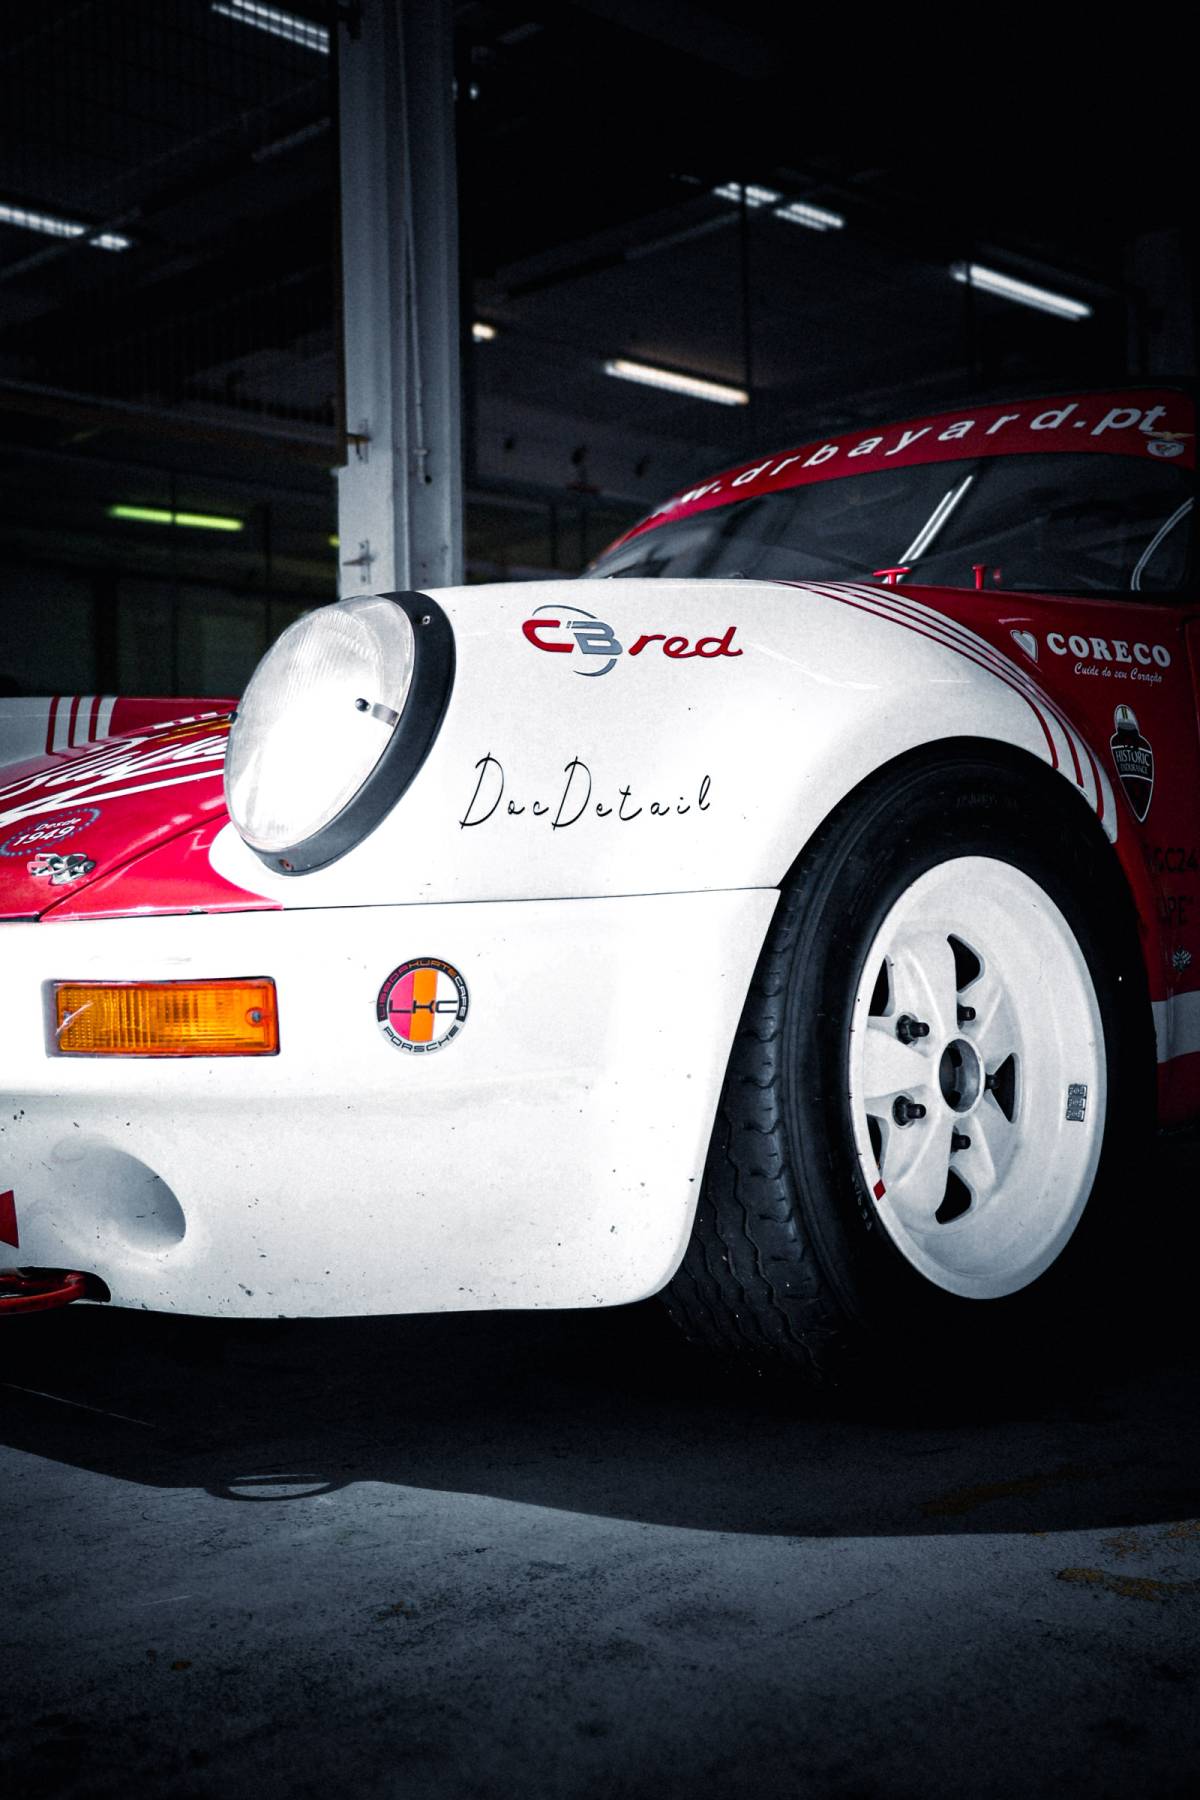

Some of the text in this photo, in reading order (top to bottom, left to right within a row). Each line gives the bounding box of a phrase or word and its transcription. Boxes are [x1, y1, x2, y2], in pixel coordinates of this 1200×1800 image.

[1046, 632, 1171, 668] CORECO
[1115, 749, 1151, 767] HISTORIC
[12, 825, 76, 847] 1949
[383, 1024, 460, 1053] PORSCHE
